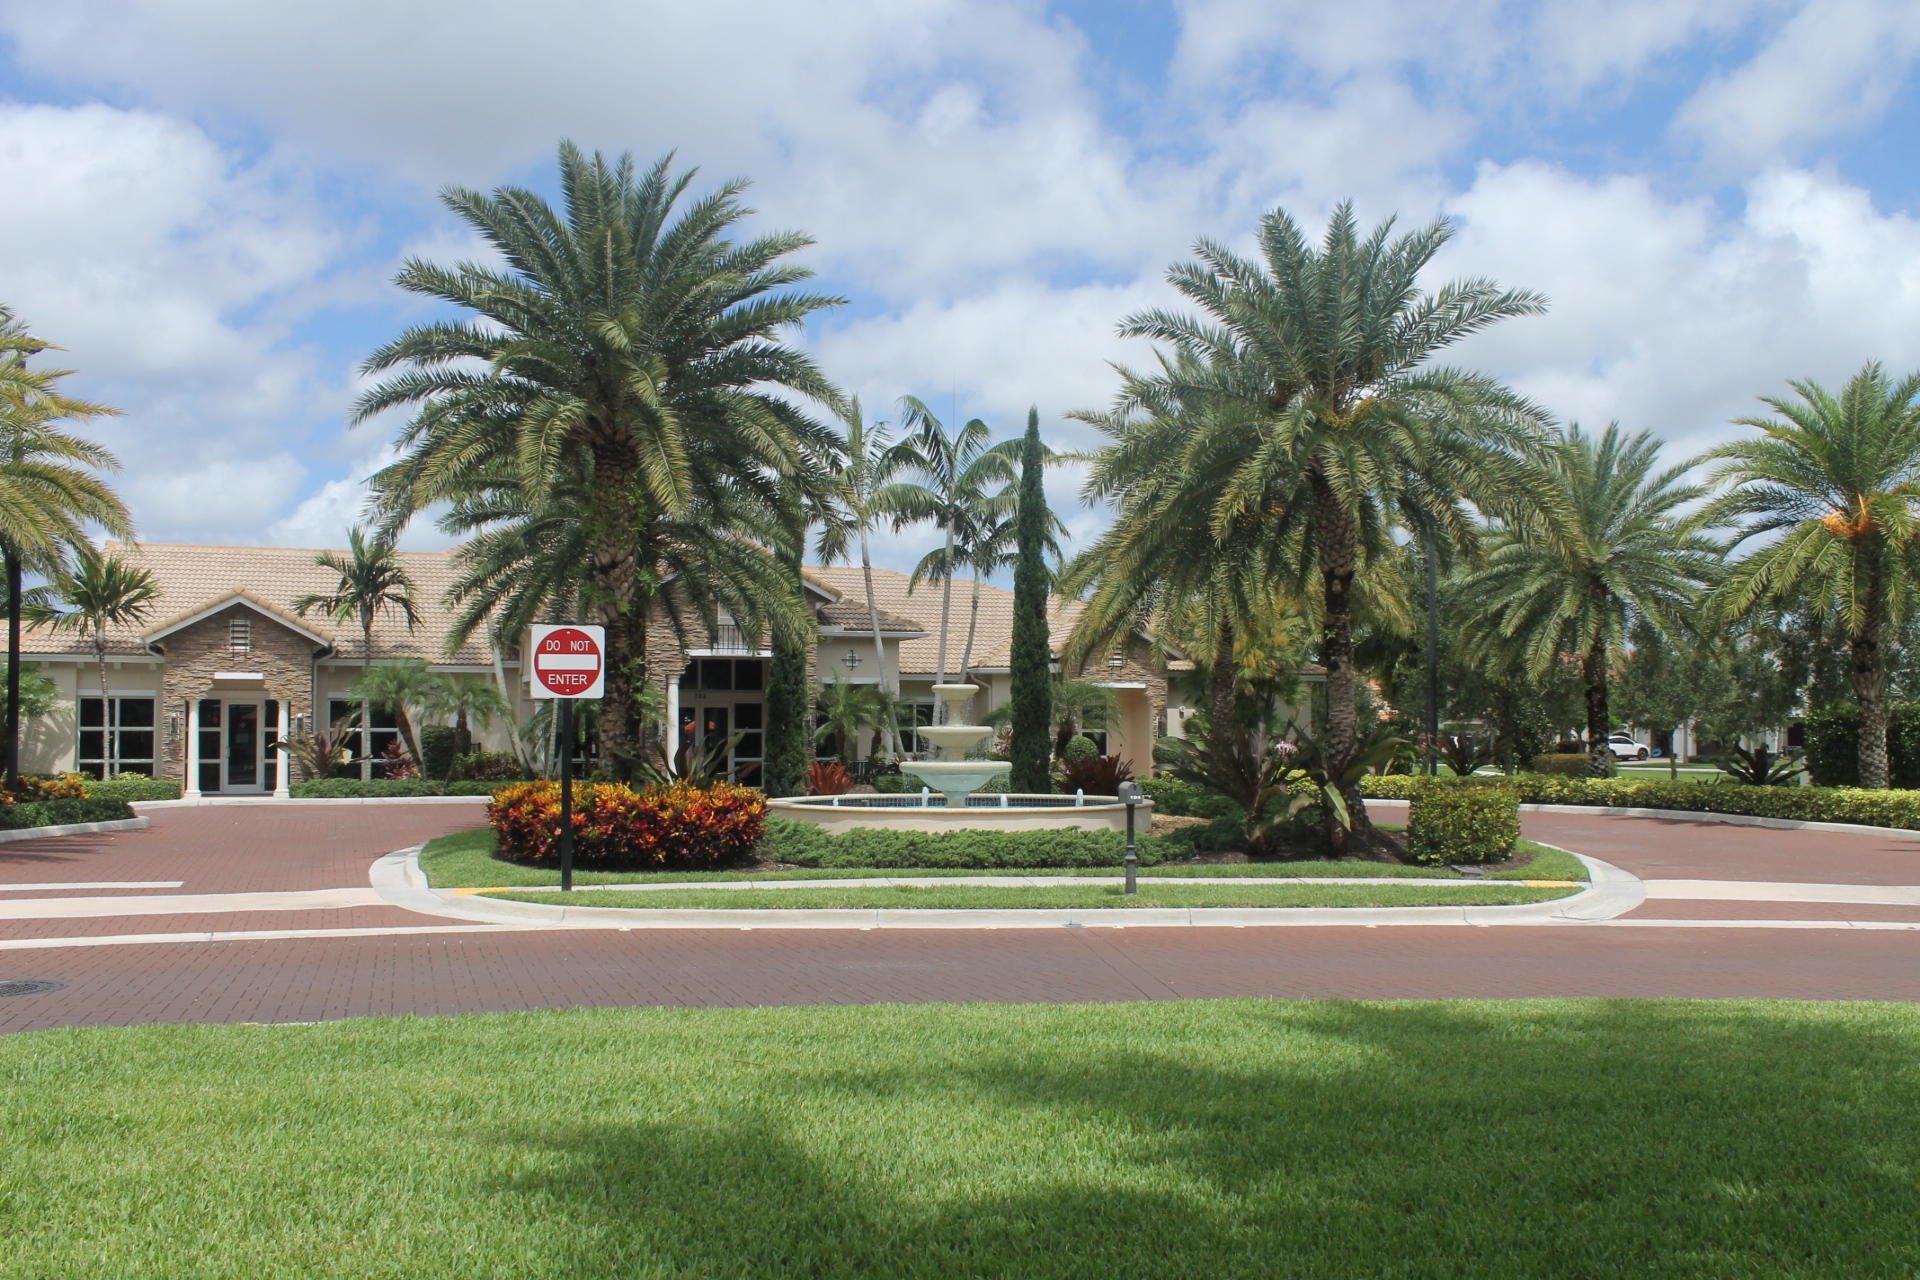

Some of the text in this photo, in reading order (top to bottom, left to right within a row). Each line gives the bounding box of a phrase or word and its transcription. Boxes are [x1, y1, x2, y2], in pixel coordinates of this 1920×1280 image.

[546, 640, 590, 651] DO NOT
[548, 674, 588, 685] ENTER
